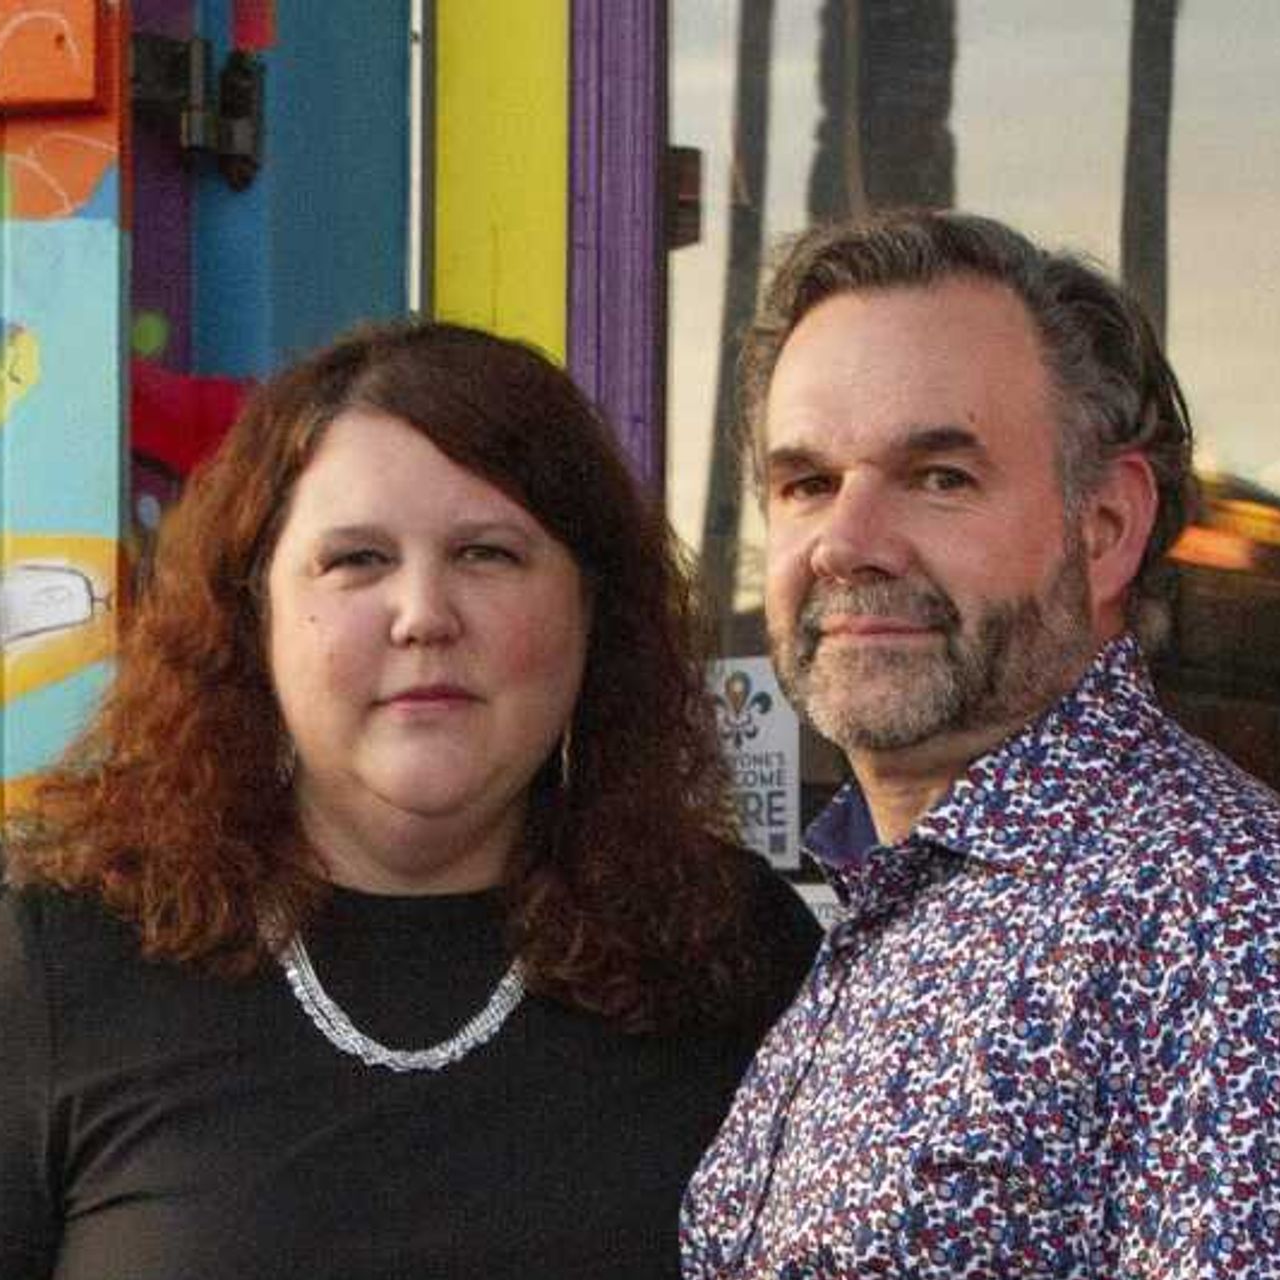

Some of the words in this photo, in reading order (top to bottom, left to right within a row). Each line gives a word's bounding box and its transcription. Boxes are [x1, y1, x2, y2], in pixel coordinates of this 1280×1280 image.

[732, 751, 786, 769] YONE'S
[734, 768, 787, 788] COME
[740, 790, 787, 827] RE
